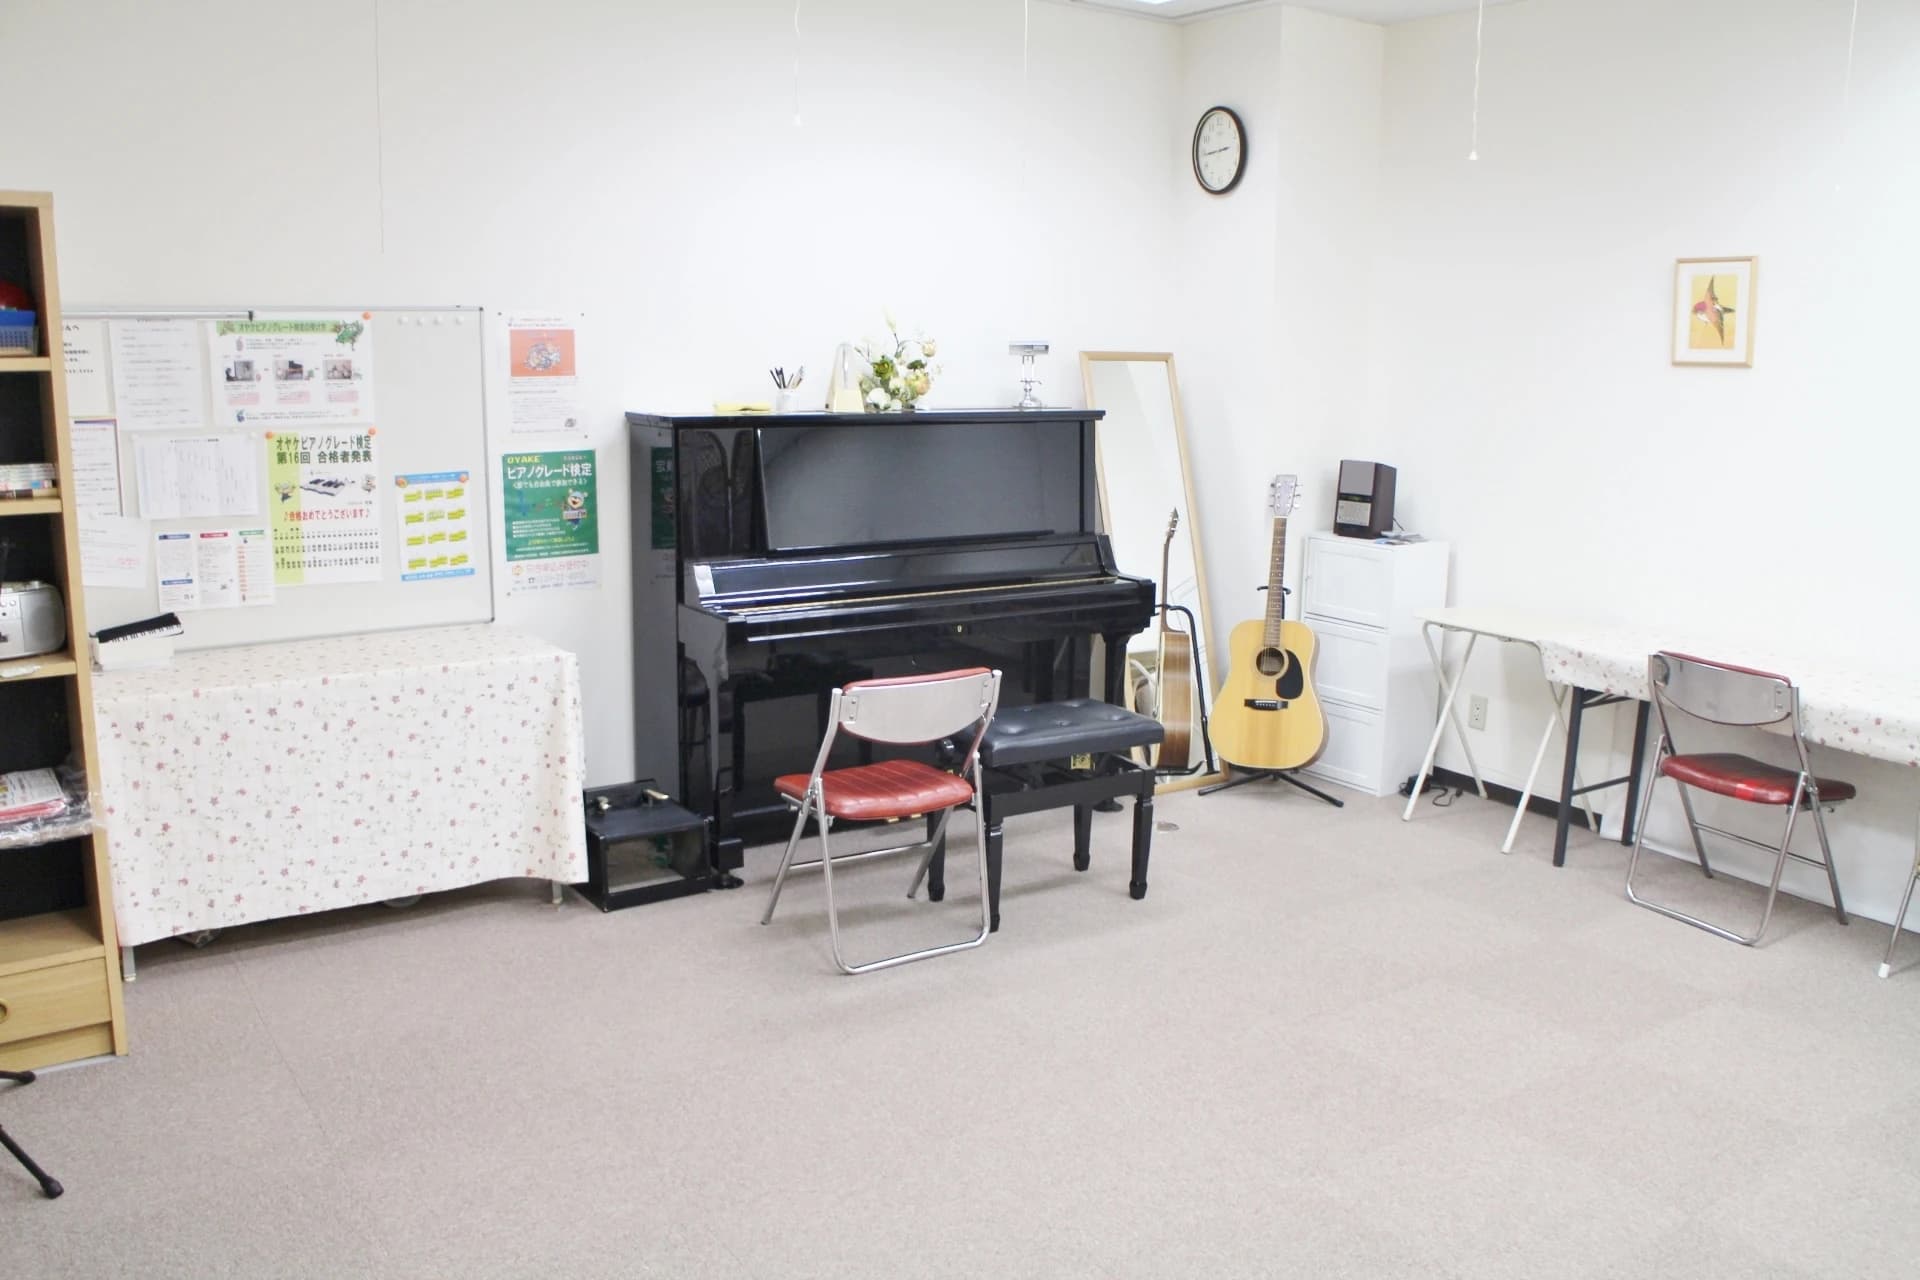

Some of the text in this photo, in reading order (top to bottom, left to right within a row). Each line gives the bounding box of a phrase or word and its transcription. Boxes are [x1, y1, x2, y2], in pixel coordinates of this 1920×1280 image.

[276, 435, 372, 451] オヤケピアノグレード検定
[276, 450, 372, 465] 第16回 合格者発表
[507, 455, 541, 464] OYAKE
[507, 463, 592, 480] ピアノグレード検定
